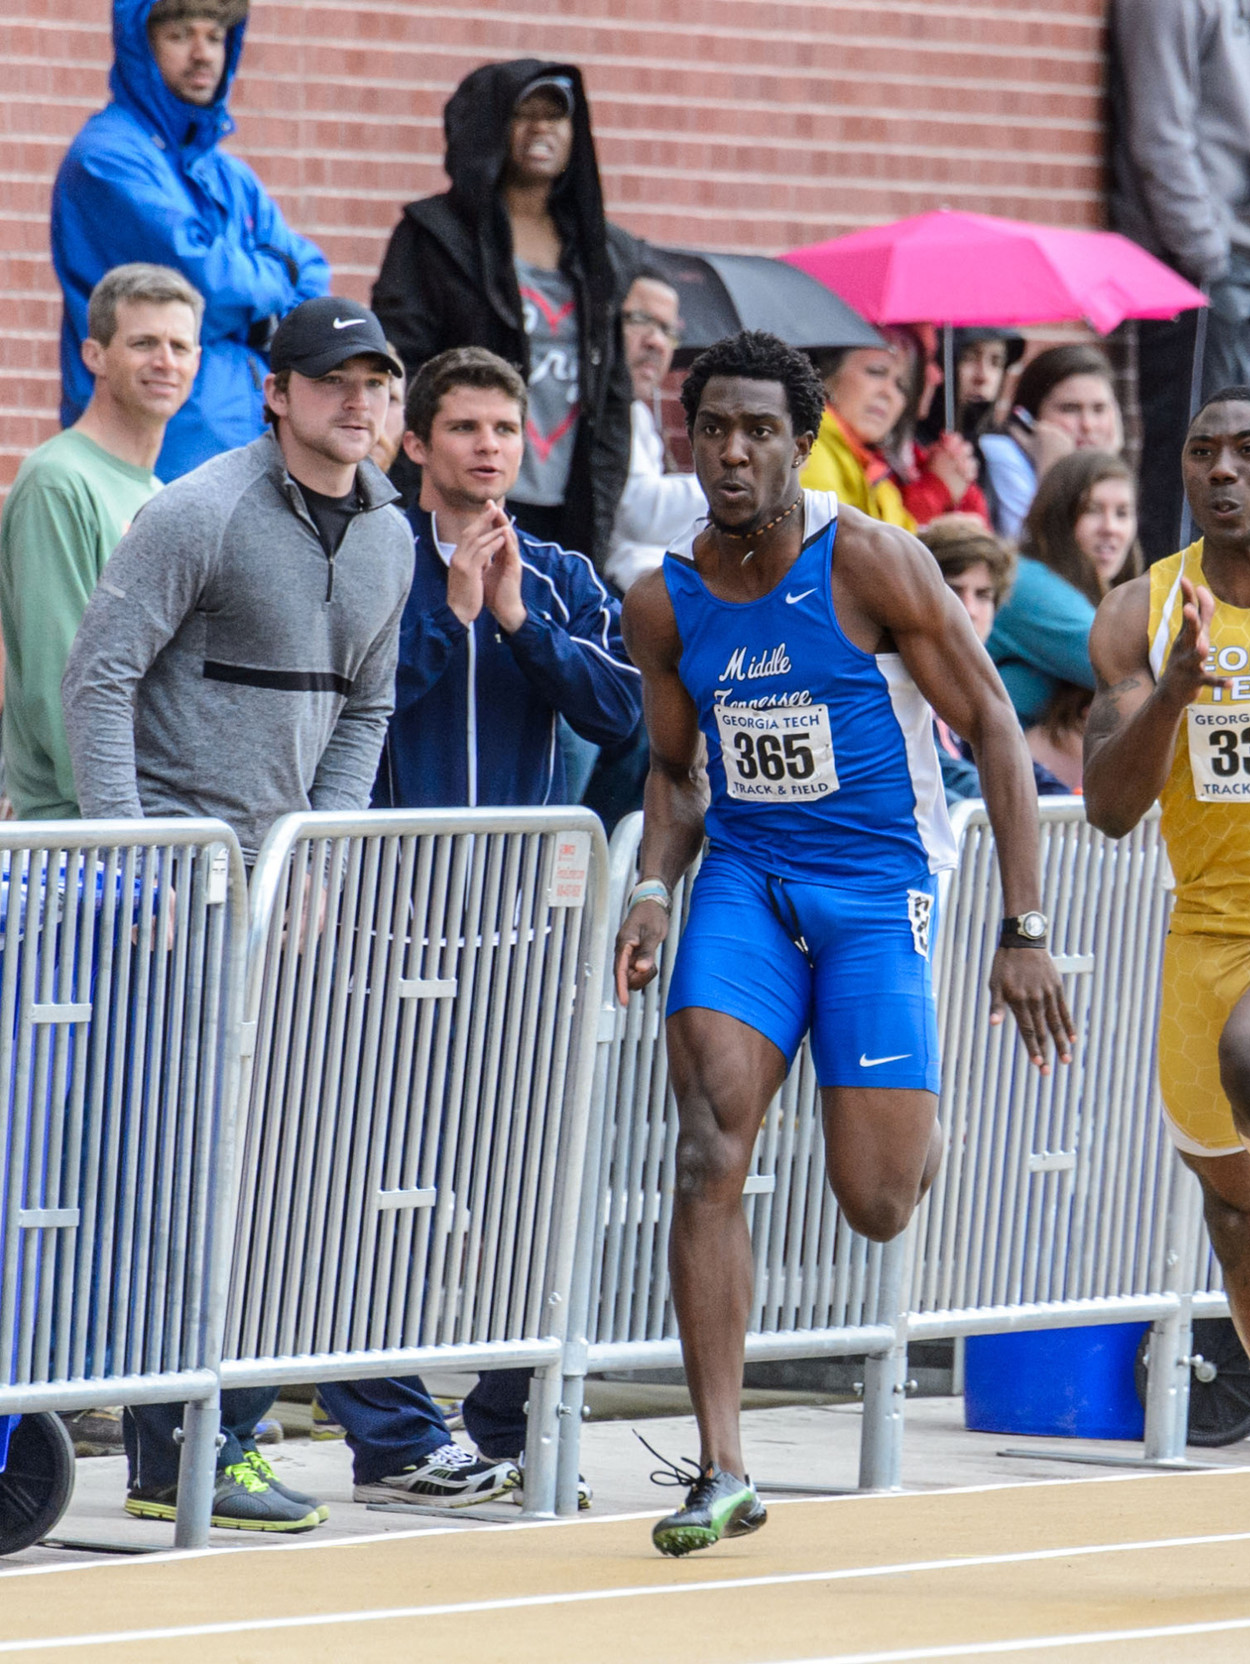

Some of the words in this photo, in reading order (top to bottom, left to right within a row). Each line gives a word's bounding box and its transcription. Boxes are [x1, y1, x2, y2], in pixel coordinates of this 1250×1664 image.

[718, 643, 792, 681] Middle
[722, 714, 778, 730] GEORGIA
[783, 714, 820, 729] TECH
[733, 731, 816, 781] 365
[734, 781, 773, 795] TRACK
[778, 785, 787, 795] &
[792, 782, 829, 795] FIELD
[1203, 782, 1250, 795] TRACK
